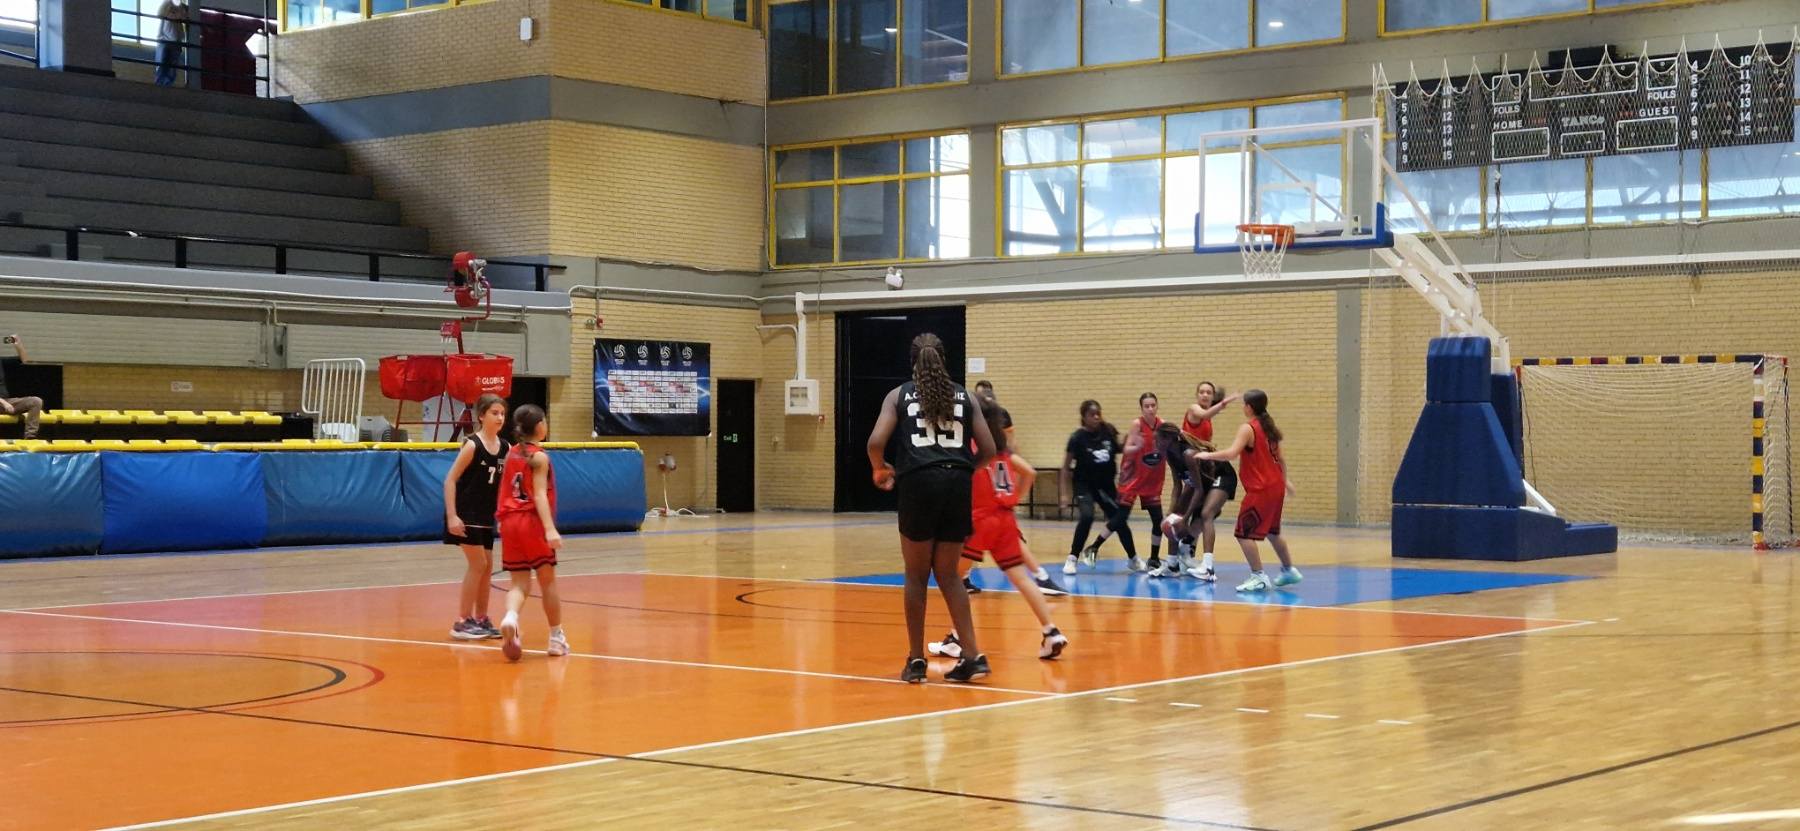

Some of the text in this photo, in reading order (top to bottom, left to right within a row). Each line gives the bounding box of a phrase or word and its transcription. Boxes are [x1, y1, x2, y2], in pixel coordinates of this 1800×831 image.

[1691, 60, 1698, 71] 4
[1740, 55, 1751, 66] 10
[1691, 74, 1698, 84] 5
[1740, 69, 1750, 79] 11
[1441, 85, 1452, 95] 10
[1690, 88, 1698, 98] 6
[1740, 84, 1751, 94] 12
[1647, 90, 1676, 100] FOULS
[1401, 103, 1407, 113] 5
[1442, 99, 1451, 109] 11
[1691, 102, 1698, 112] 7
[1740, 98, 1751, 108] 13
[1493, 105, 1520, 115] FOULS
[1639, 106, 1676, 117] GUEST
[1401, 116, 1408, 126] 6
[1442, 112, 1452, 121] 12
[1691, 116, 1698, 126] 8
[1740, 112, 1751, 122] 14
[1442, 125, 1453, 134] 13
[1493, 120, 1523, 130] HOME
[1401, 129, 1408, 139] 7
[1691, 130, 1698, 140] 9
[1740, 126, 1751, 136] 15
[1401, 142, 1408, 151] 8
[1442, 138, 1452, 148] 14
[1402, 154, 1408, 164] 9
[1443, 151, 1453, 160] 15
[907, 402, 963, 448] 35
[488, 466, 496, 485] 7
